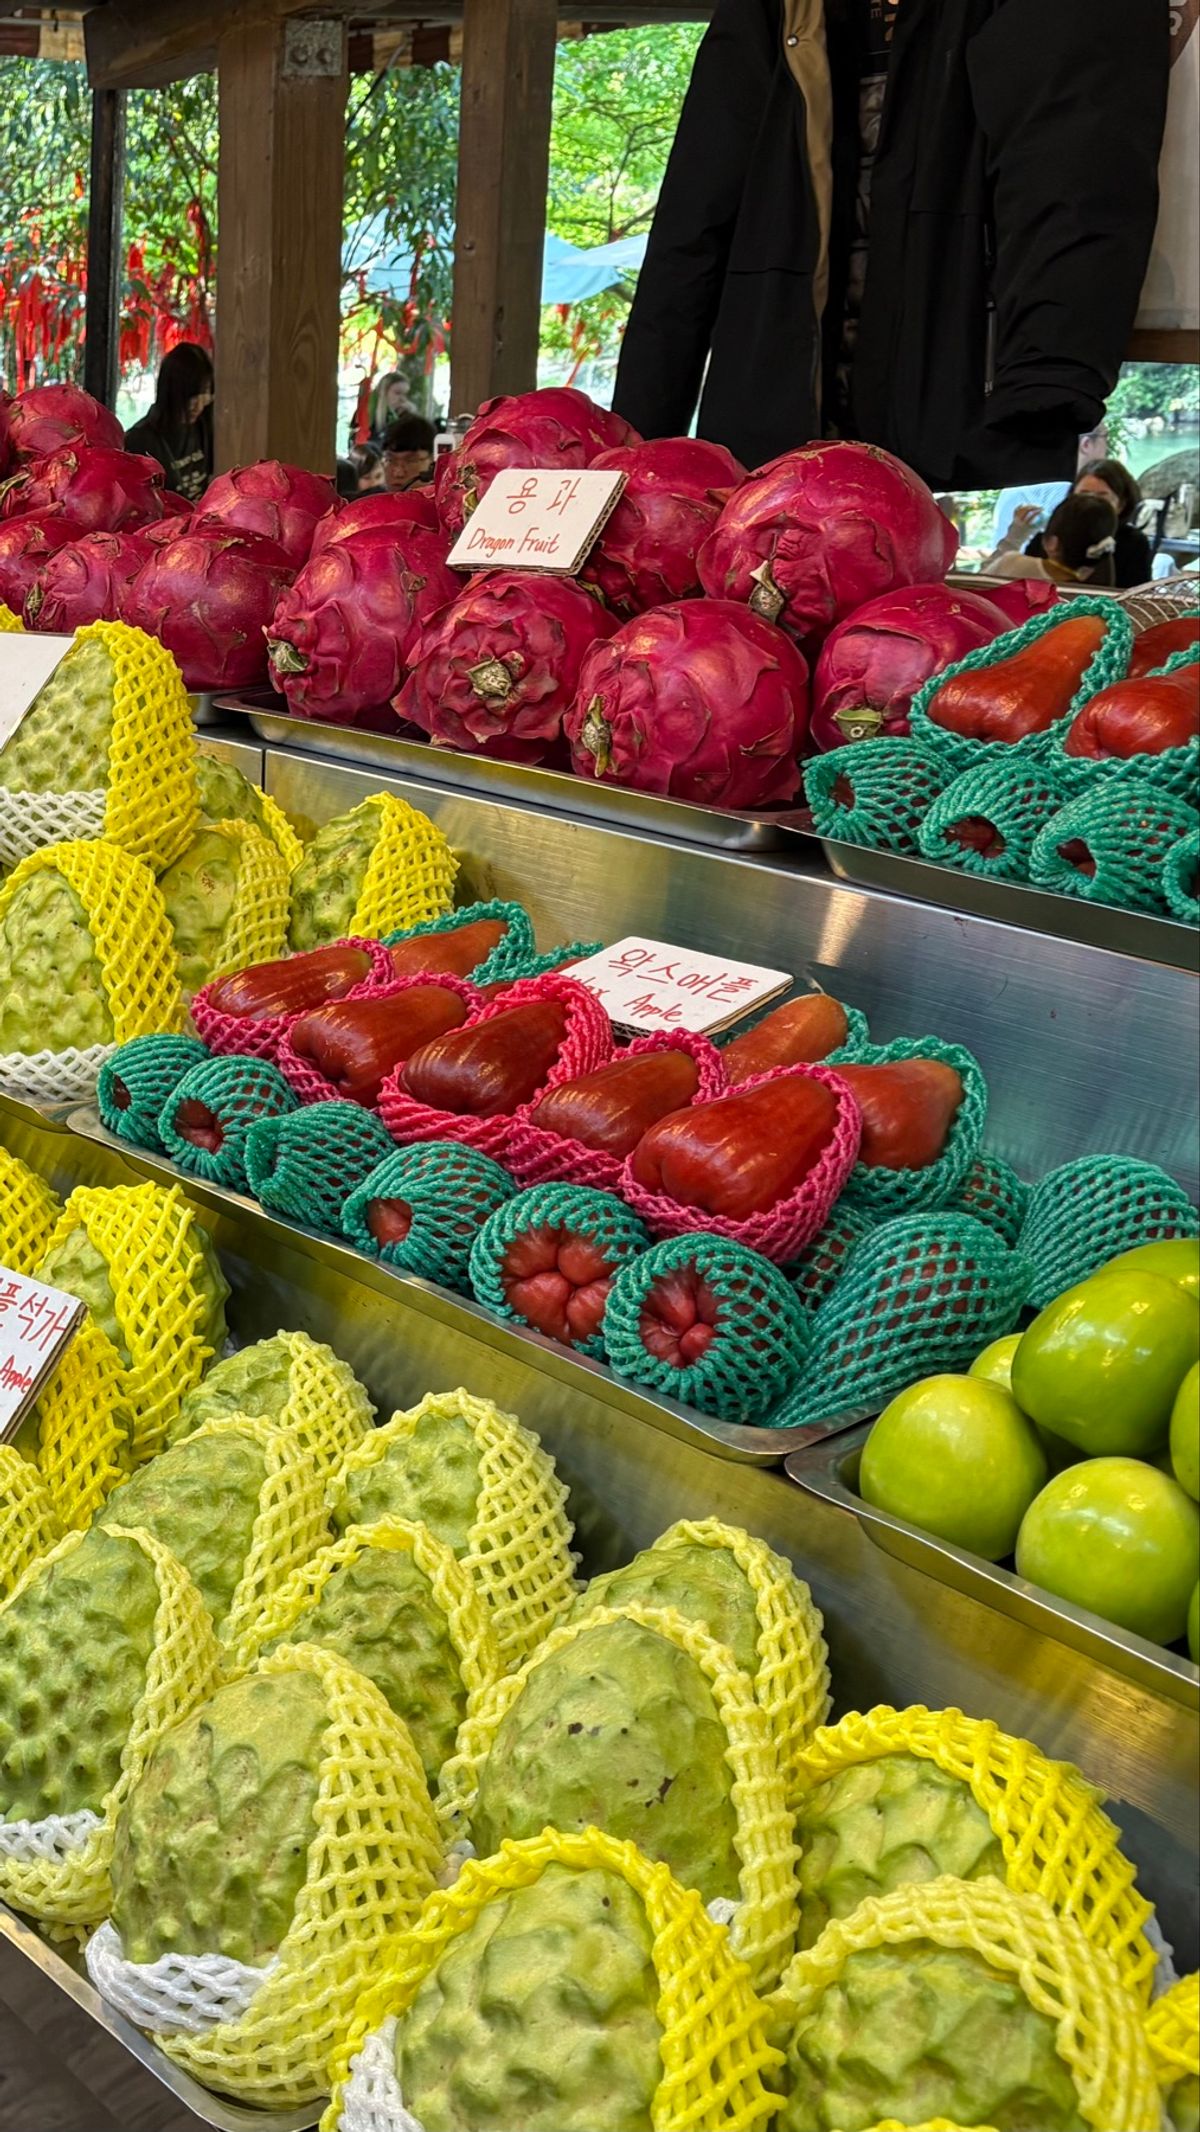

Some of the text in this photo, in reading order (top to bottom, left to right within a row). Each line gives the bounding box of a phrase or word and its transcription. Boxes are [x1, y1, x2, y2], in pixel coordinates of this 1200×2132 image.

[467, 527, 560, 558] Dragon Fruit
[608, 949, 759, 1003] 왁스애플
[623, 992, 685, 1023] Apple
[0, 1277, 69, 1352] 플석가
[0, 1354, 33, 1394] Apple
